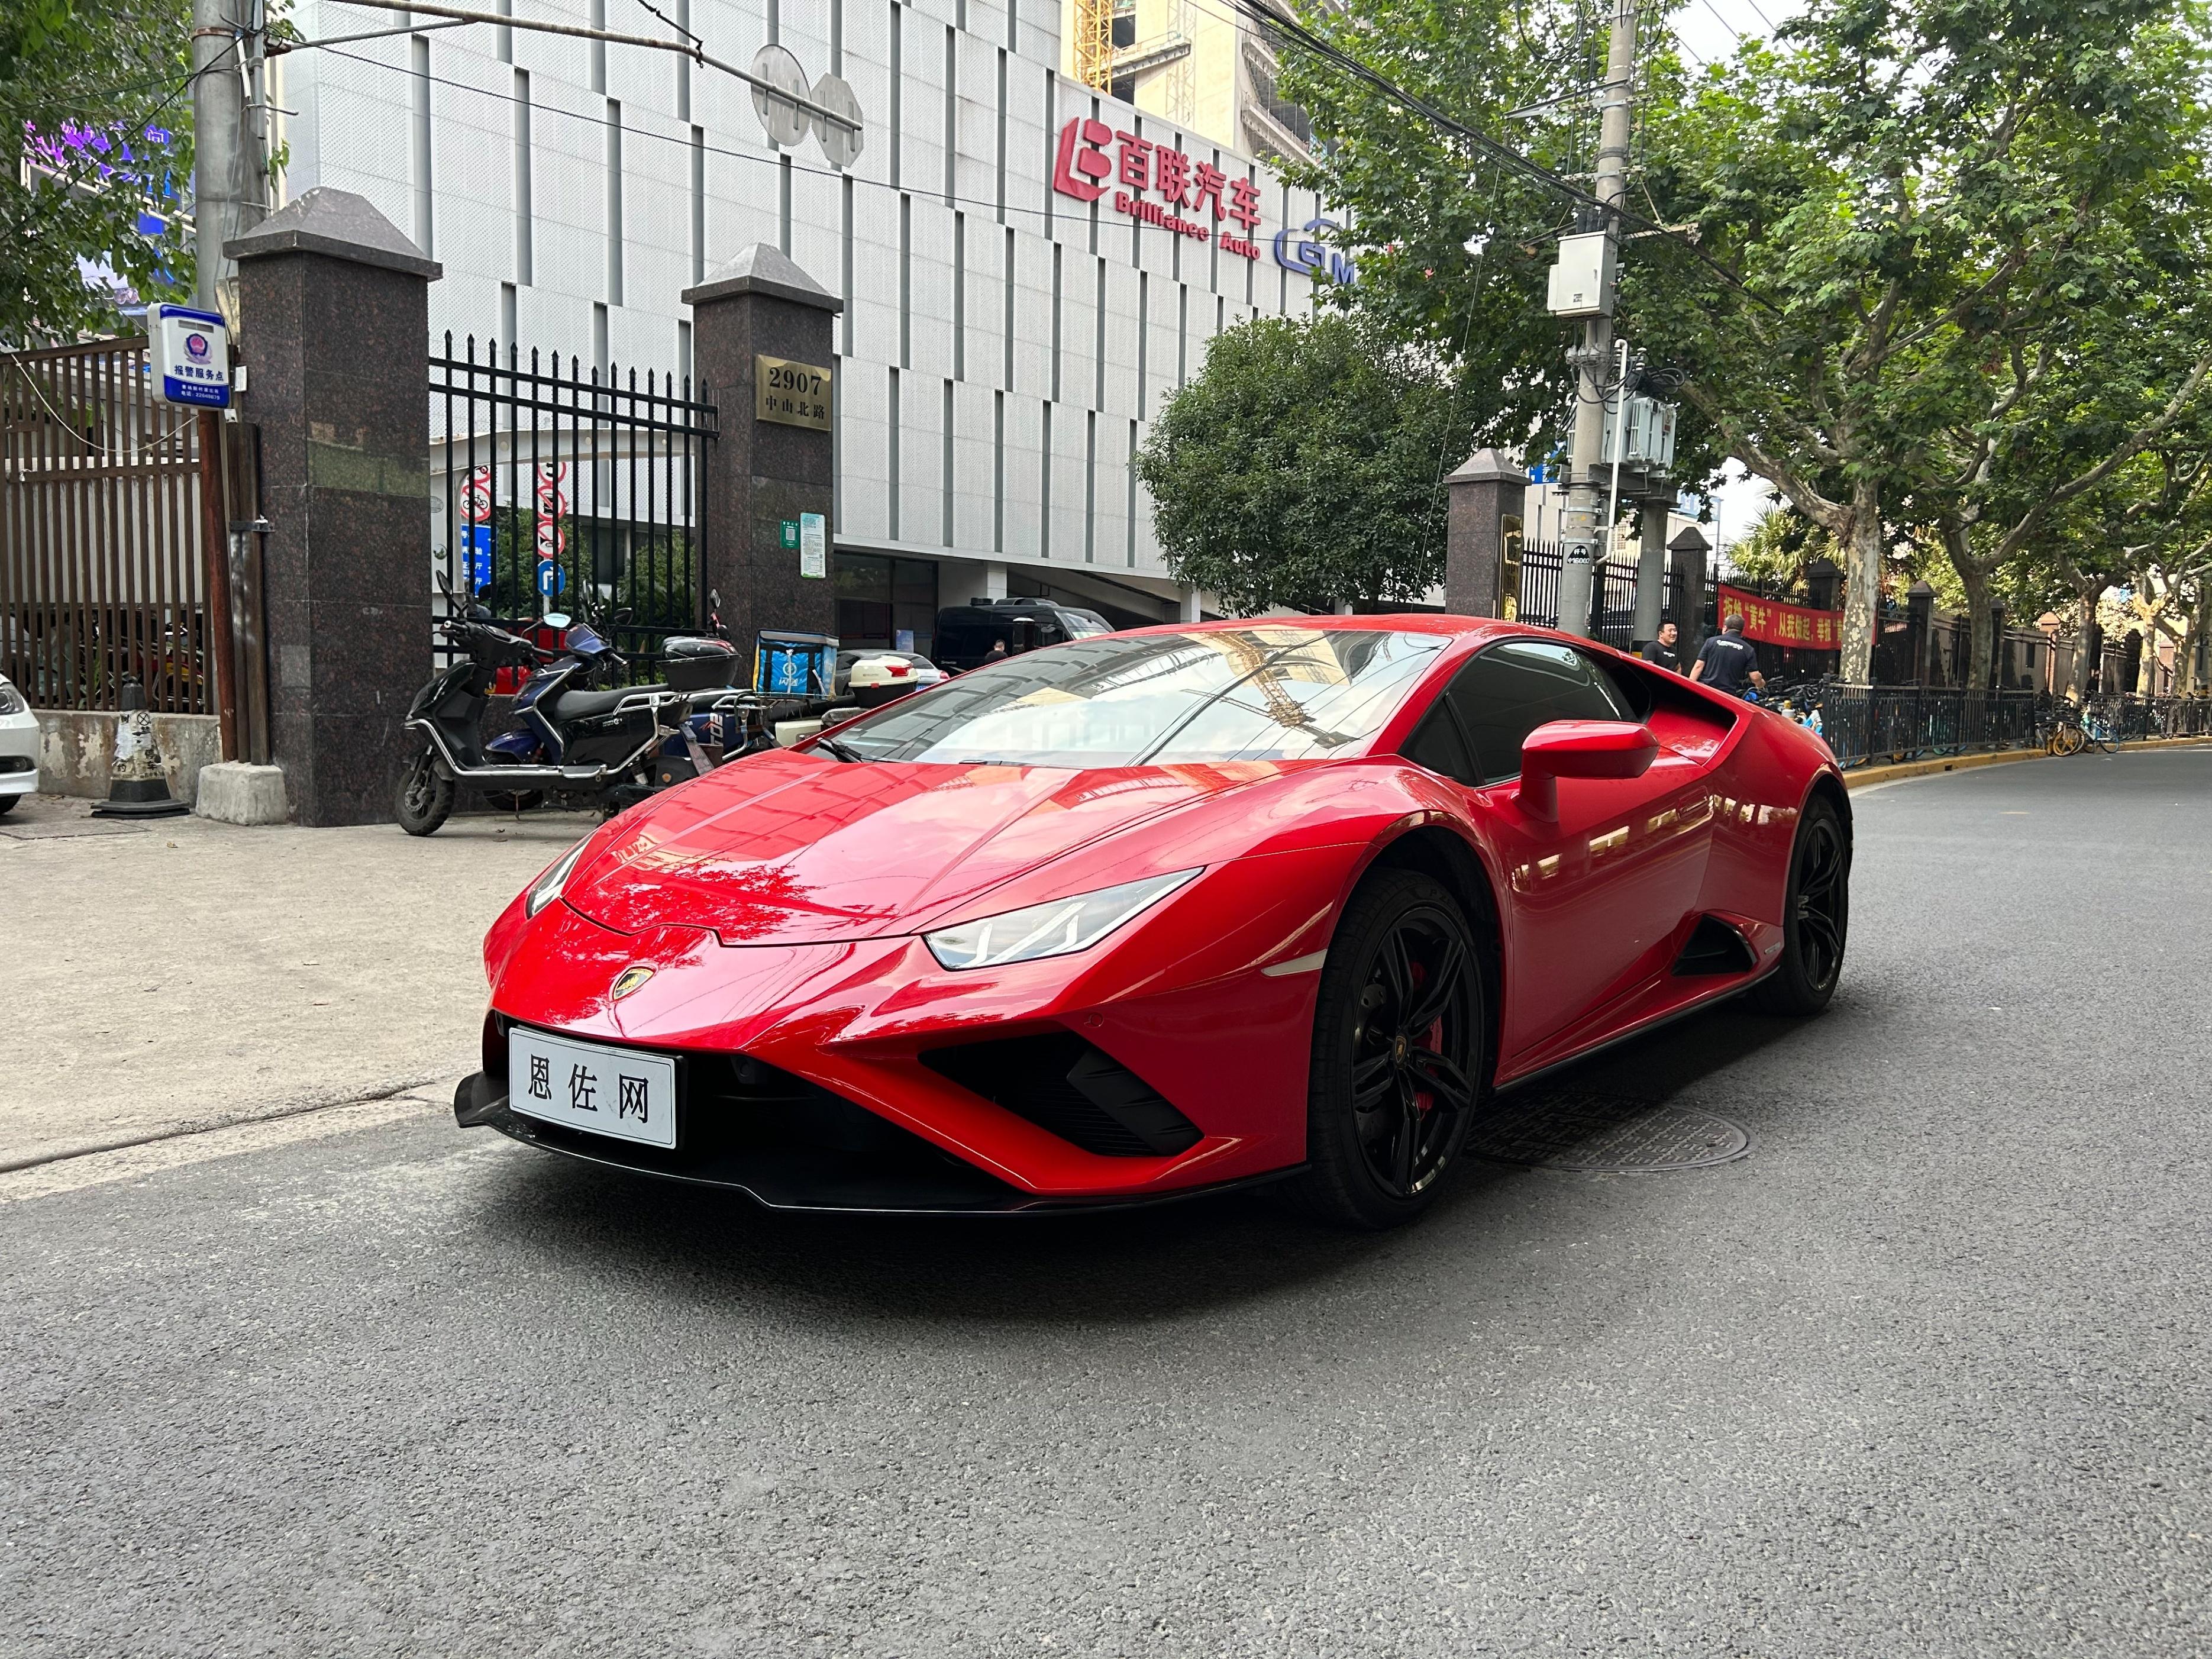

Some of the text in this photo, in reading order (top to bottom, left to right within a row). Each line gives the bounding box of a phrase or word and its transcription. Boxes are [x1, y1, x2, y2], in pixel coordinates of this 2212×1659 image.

[1116, 130, 1261, 230] 百联汽车
[1116, 191, 1209, 241] Brilliance
[1220, 231, 1261, 260] Auto
[175, 364, 223, 381] 报警服务点
[769, 367, 821, 395] 2907
[766, 395, 824, 419] 中山北路
[528, 1054, 648, 1123] 恩佐网
